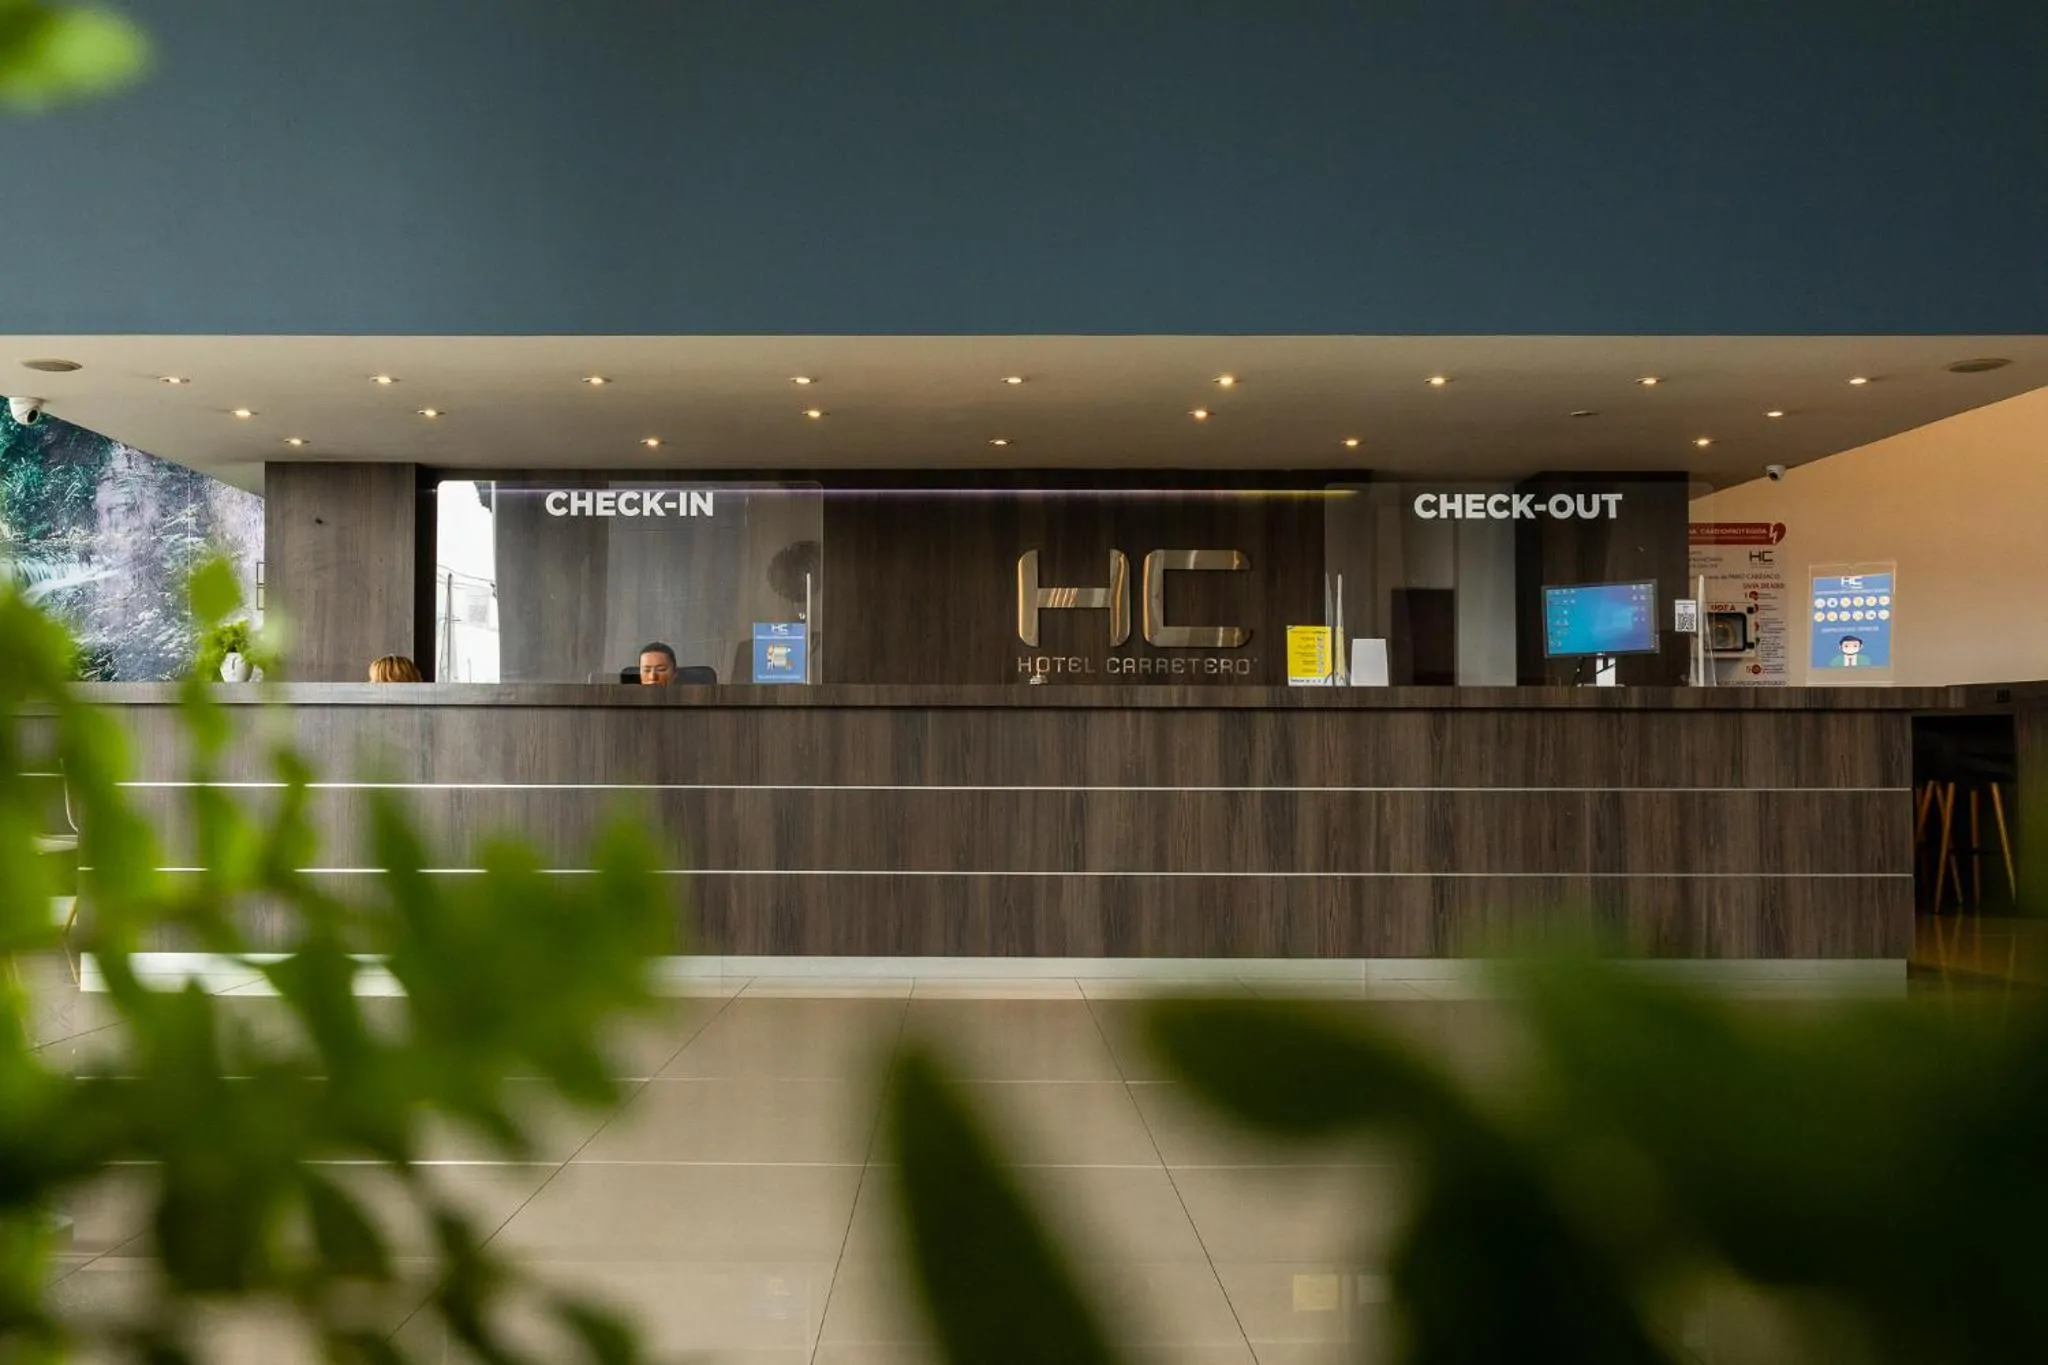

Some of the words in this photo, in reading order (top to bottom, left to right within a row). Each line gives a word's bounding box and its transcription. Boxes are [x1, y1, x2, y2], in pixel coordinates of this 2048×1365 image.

[545, 491, 714, 517] CHECK-IN
[1414, 493, 1623, 519] CHECK-OUT
[1749, 550, 1774, 562] HC
[1841, 576, 1863, 586] HC
[1017, 549, 1253, 648] HC
[1017, 656, 1096, 673] HOTEL
[1106, 657, 1250, 675] CARRETERO
